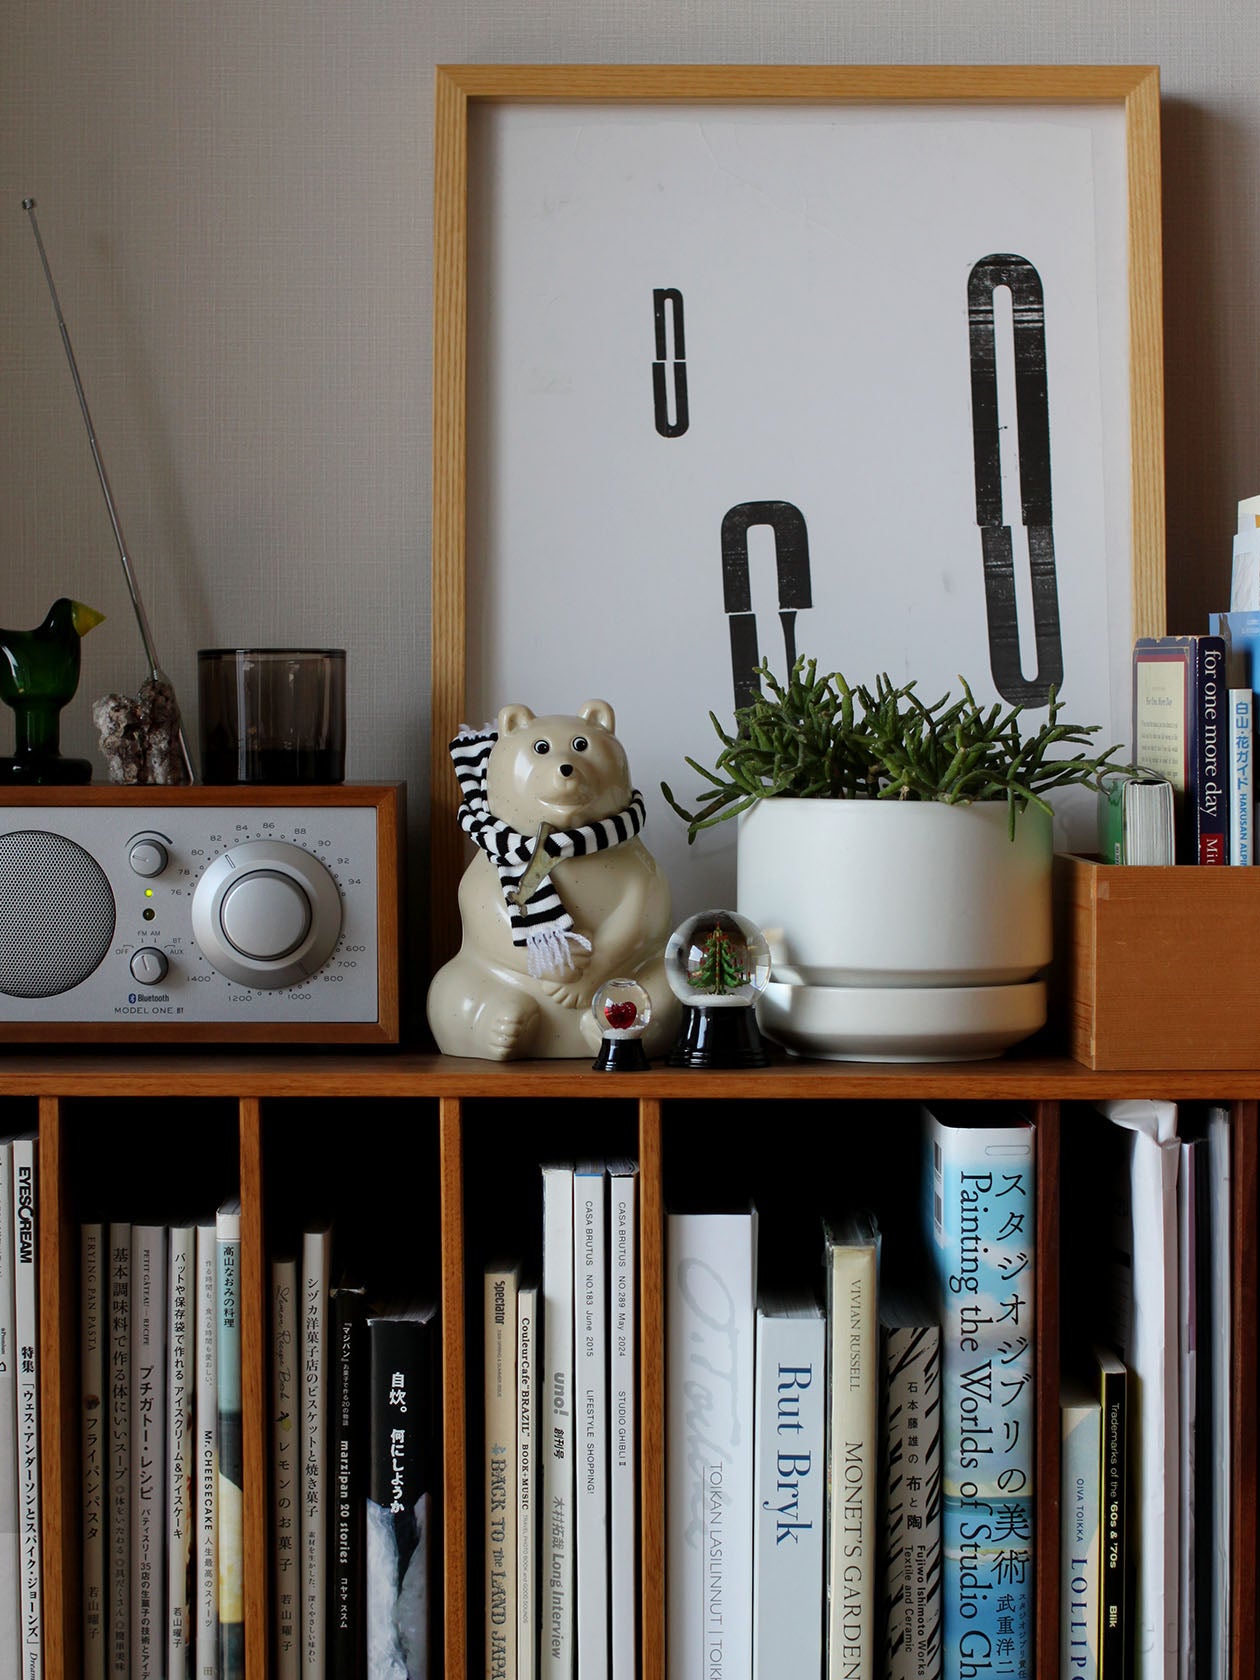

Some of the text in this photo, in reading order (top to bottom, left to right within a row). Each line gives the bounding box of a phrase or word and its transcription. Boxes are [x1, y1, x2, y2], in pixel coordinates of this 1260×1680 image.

[1200, 649, 1222, 817] for one more day
[1239, 793, 1248, 840] HAKUSAN
[137, 994, 169, 1002] Bluetooth
[18, 1166, 33, 1264] EYESCREAM
[949, 1171, 992, 1295] Painting
[87, 1236, 97, 1352] FRYING PAN PASTA
[173, 1252, 186, 1381] バットや保存袋で作れる
[223, 1246, 235, 1328] 高山なおみの料理
[494, 1280, 505, 1325] Spectator
[584, 1201, 594, 1357] CASA BRUTUS NO.183 June 2015
[617, 1202, 626, 1357] CASA BRUTUS NO.289 May 2024
[960, 1305, 993, 1351] the
[21, 1346, 35, 1374] 特集
[849, 1279, 861, 1392] VIVIAN RUSSELL
[991, 1174, 1032, 1585] スタジオジブリの美術
[140, 1364, 154, 1501] プチガトー・レシピ
[389, 1371, 408, 1514] 自炊。 何にしようか
[553, 1371, 569, 1416] uno!
[586, 1389, 595, 1495] LIFESTYLE SHOPPING!
[618, 1390, 626, 1426] STUDIO
[959, 1360, 993, 1469] Worlds
[1110, 1403, 1120, 1465] Trademarks
[86, 1417, 100, 1540] フライパンパスタ
[204, 1430, 213, 1531] Mr. CHEESECAKE
[490, 1459, 506, 1512] BACK
[618, 1428, 626, 1460] GHIBLI
[763, 1363, 813, 1546] Rut Bryk
[1110, 1467, 1119, 1479] of
[1110, 1481, 1119, 1498] the
[278, 1442, 292, 1572] レモンのお菓子
[338, 1440, 351, 1564] marzipan 20 stories
[490, 1517, 505, 1542] TO
[844, 1442, 863, 1558] MONET'S
[960, 1482, 993, 1516] of
[1076, 1478, 1084, 1542] OIVA TOIKKA
[490, 1570, 507, 1625] LAND
[550, 1553, 565, 1587] Long
[709, 1462, 723, 1680] TOIKAN LASILINNUT TOIK
[904, 1545, 915, 1653] Textile and Ceramic
[915, 1545, 927, 1676] Fujiwo Ishimoto Works
[959, 1522, 993, 1619] Studio
[1070, 1558, 1088, 1680] LOLLIP
[1109, 1605, 1117, 1628] Blik
[551, 1592, 565, 1660] Interview
